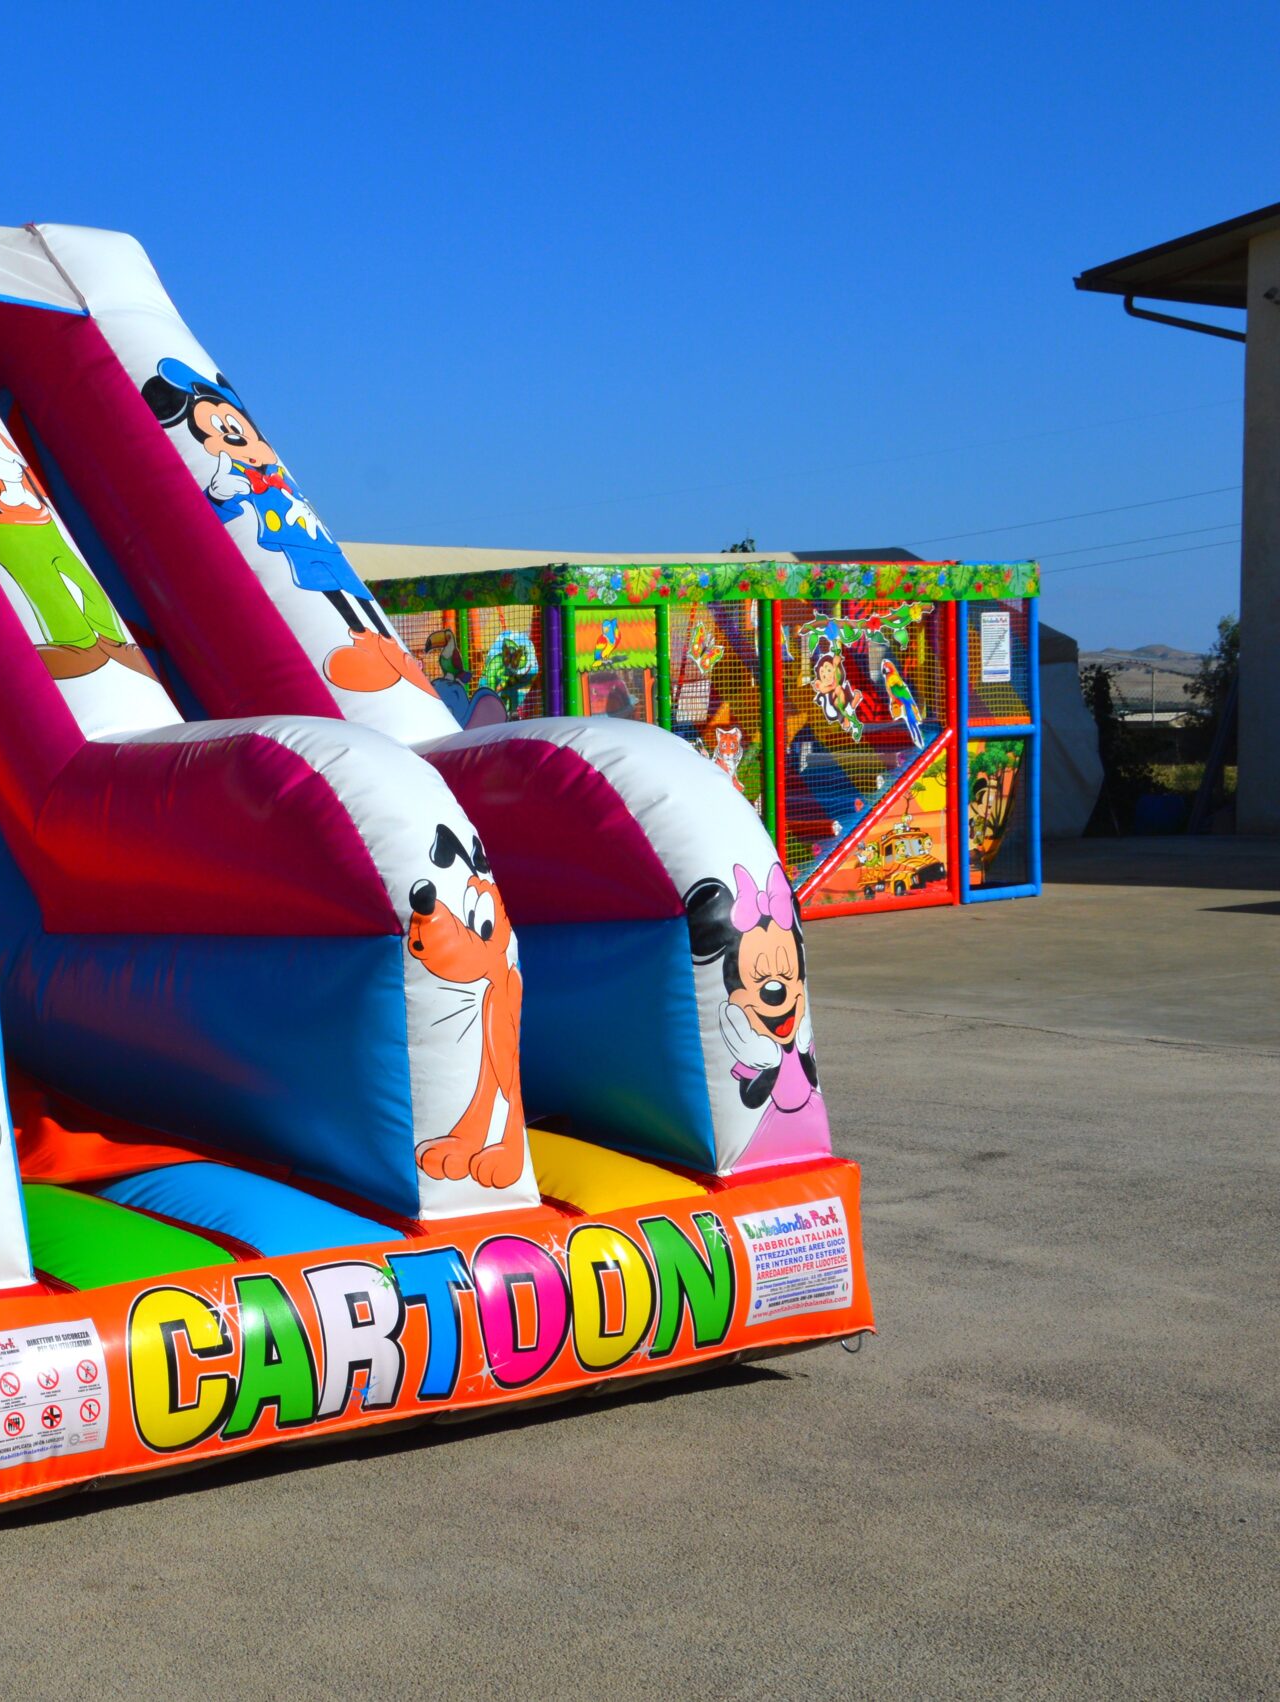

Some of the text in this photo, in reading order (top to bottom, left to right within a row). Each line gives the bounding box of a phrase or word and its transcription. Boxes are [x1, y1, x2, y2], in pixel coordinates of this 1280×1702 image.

[809, 1206, 838, 1228] Park
[752, 1228, 844, 1253] FABBRICA ITALIANA
[755, 1238, 846, 1262] ATTREZZATURE AREE GIOCO
[756, 1247, 846, 1271] PER INTERNO ED ESTERNO
[756, 1264, 802, 1280] ARREDAMENTO
[803, 1262, 815, 1271] PER
[815, 1254, 848, 1268] LUDOTECHE
[26, 1331, 90, 1347] DIRETTIVE DI SICUREZZA
[125, 1210, 737, 1455] CARTOON
